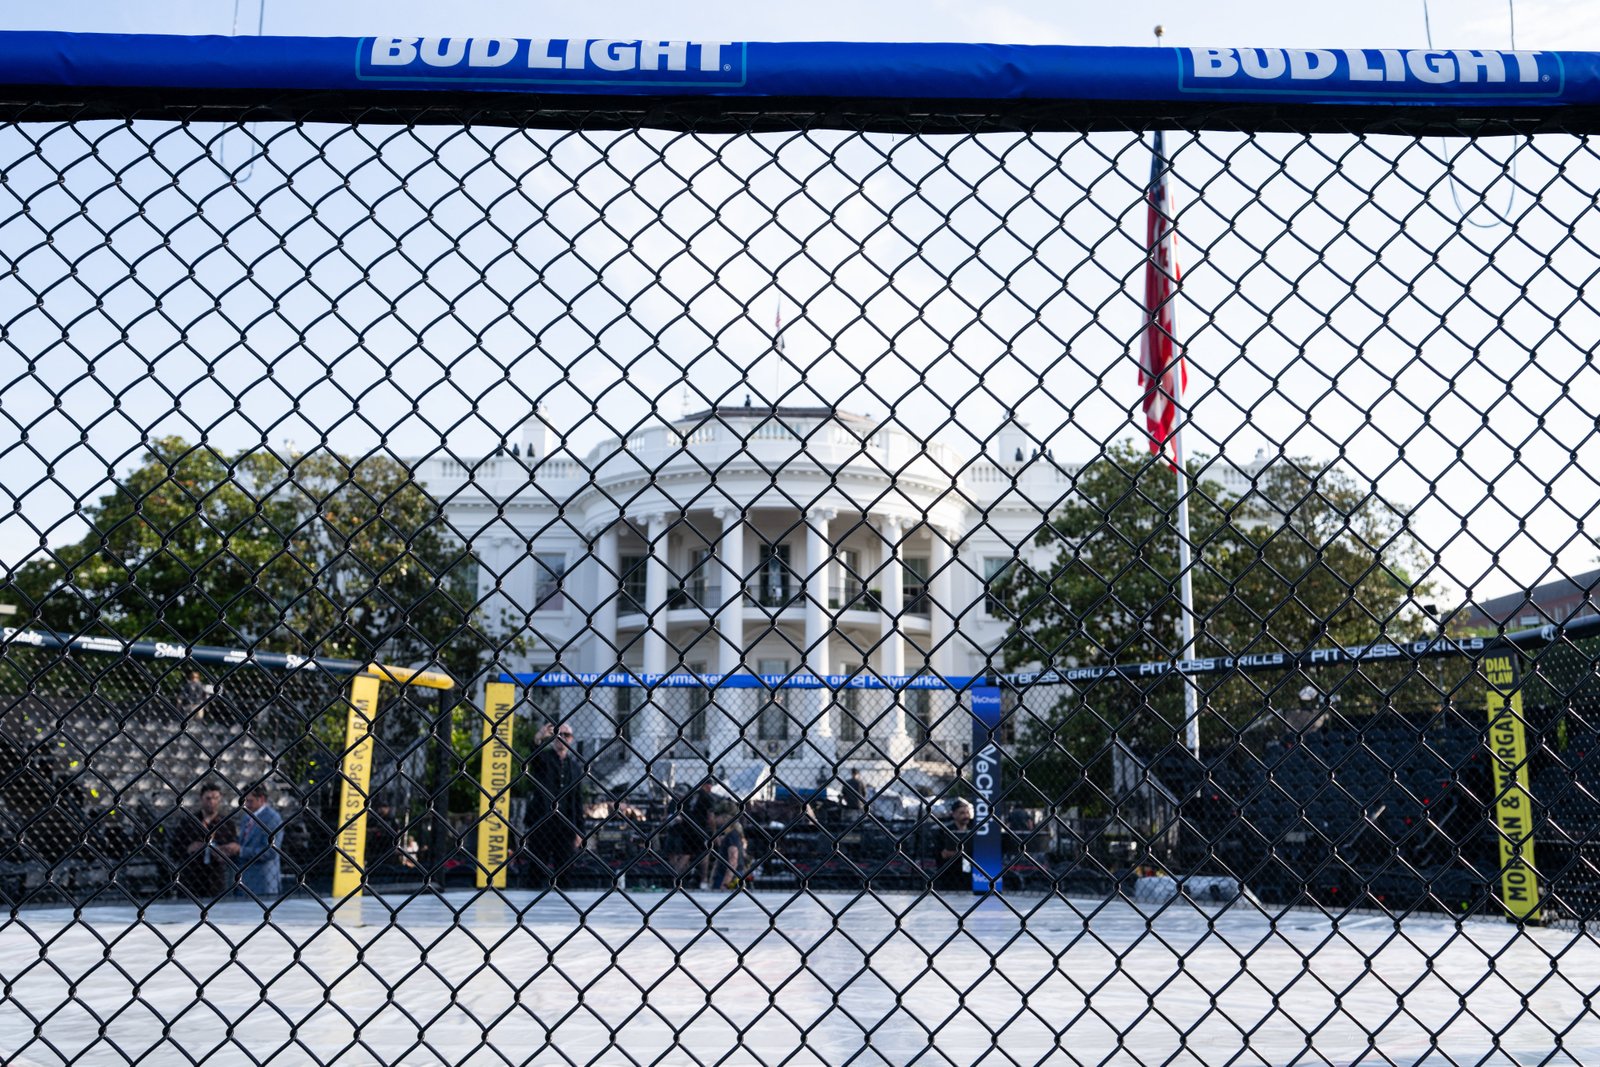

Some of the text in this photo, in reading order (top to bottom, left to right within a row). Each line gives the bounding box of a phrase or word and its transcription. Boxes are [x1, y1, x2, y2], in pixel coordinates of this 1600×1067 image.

[371, 36, 731, 71] BUD LIGHT
[1189, 47, 1543, 83] BUD LIGHT
[154, 642, 189, 660] Stak
[1485, 656, 1513, 673] DIAL
[608, 674, 625, 684] ON
[647, 673, 722, 687] Plymaket
[764, 675, 828, 685] LIVTRAD
[1495, 707, 1518, 790] MORGAN
[341, 698, 370, 874] NOTHING STOPS RM
[975, 743, 998, 836] VeChain
[1501, 796, 1520, 810] &
[488, 835, 504, 866] RAM
